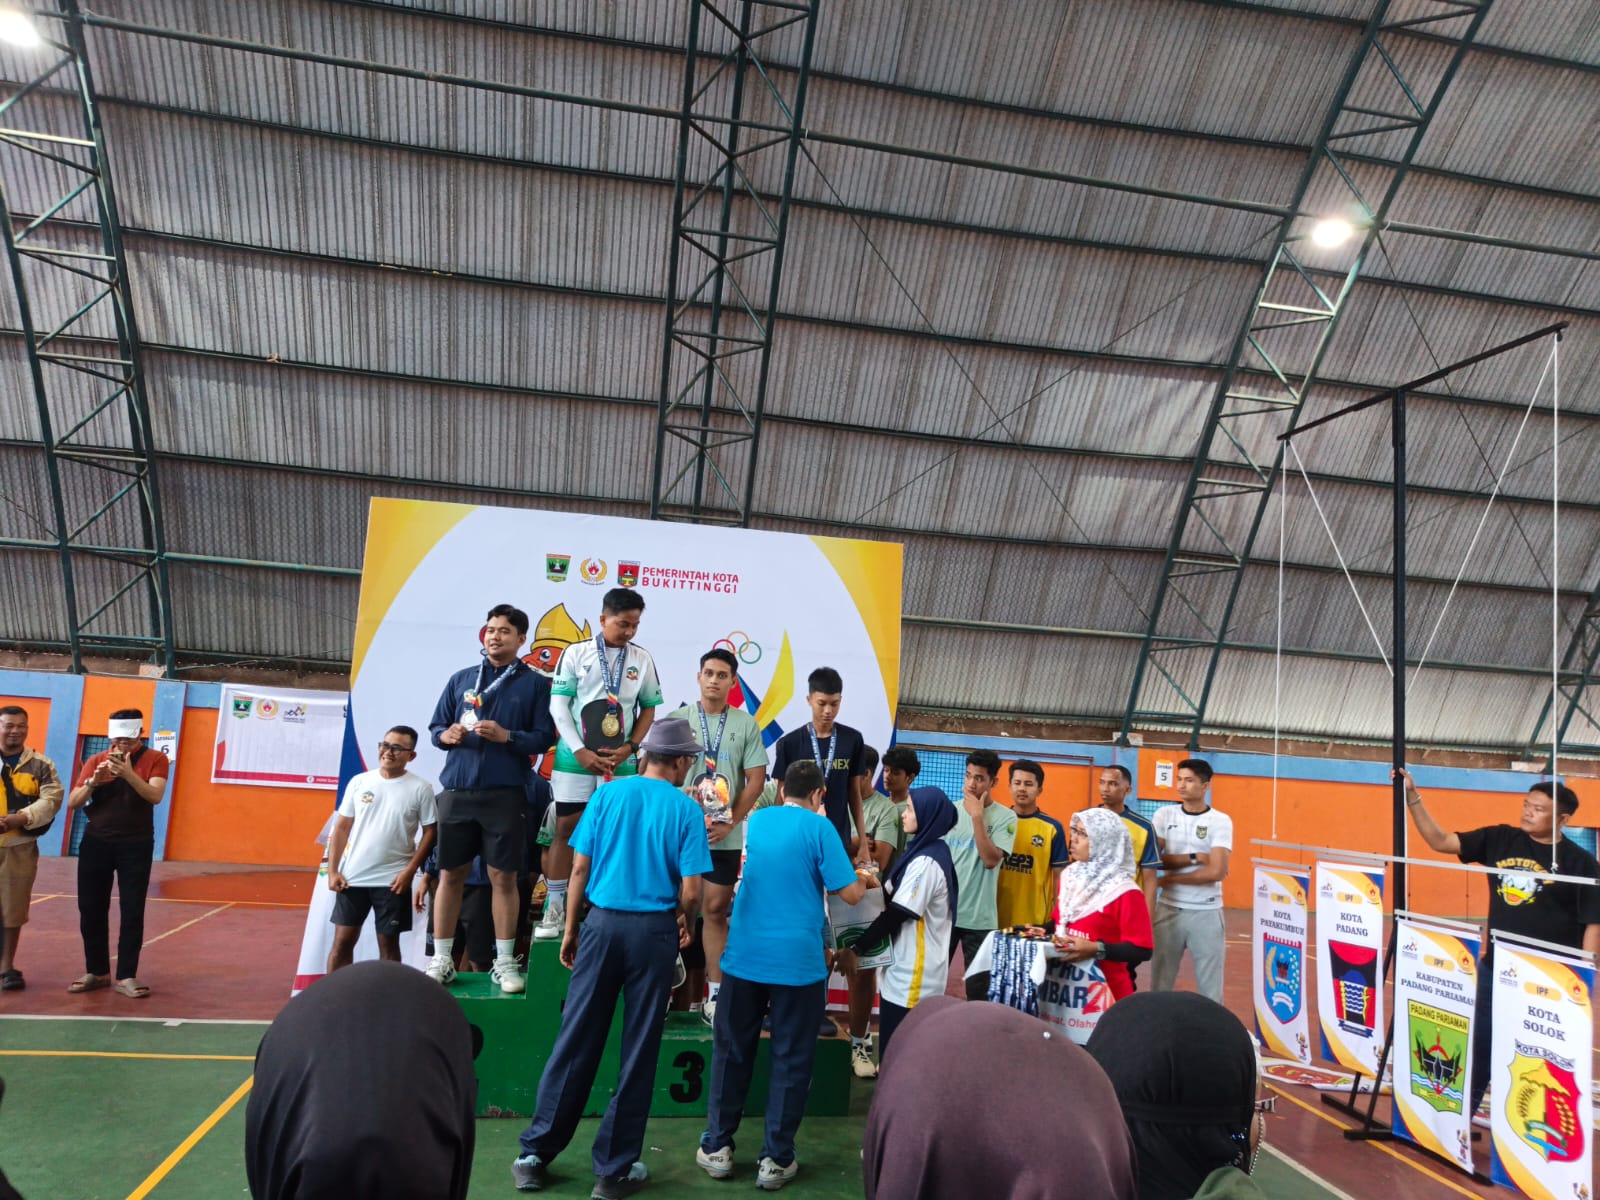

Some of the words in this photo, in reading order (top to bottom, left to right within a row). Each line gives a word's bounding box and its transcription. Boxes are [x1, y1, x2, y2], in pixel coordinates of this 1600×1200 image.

[642, 567, 710, 581] PEMERINTAH
[712, 572, 739, 584] KOTA
[641, 577, 737, 594] BUKITTINGGI
[823, 759, 850, 770] YNEX
[1161, 772, 1168, 781] 5
[1273, 909, 1292, 921] KOTA
[1340, 911, 1363, 924] KOTA
[1335, 923, 1369, 937] PADANG
[1433, 957, 1445, 967] IPF
[1401, 978, 1433, 994] PADANG
[1415, 971, 1464, 991] KABUPATEN
[1536, 986, 1549, 996] IPF
[1410, 1003, 1436, 1020] PADANG
[1436, 1011, 1467, 1030] PARIAMAN
[1527, 1005, 1561, 1024] KOTA
[1523, 1019, 1566, 1042] SOLOK
[1516, 1041, 1539, 1054] KOTA
[669, 1050, 705, 1104] 3
